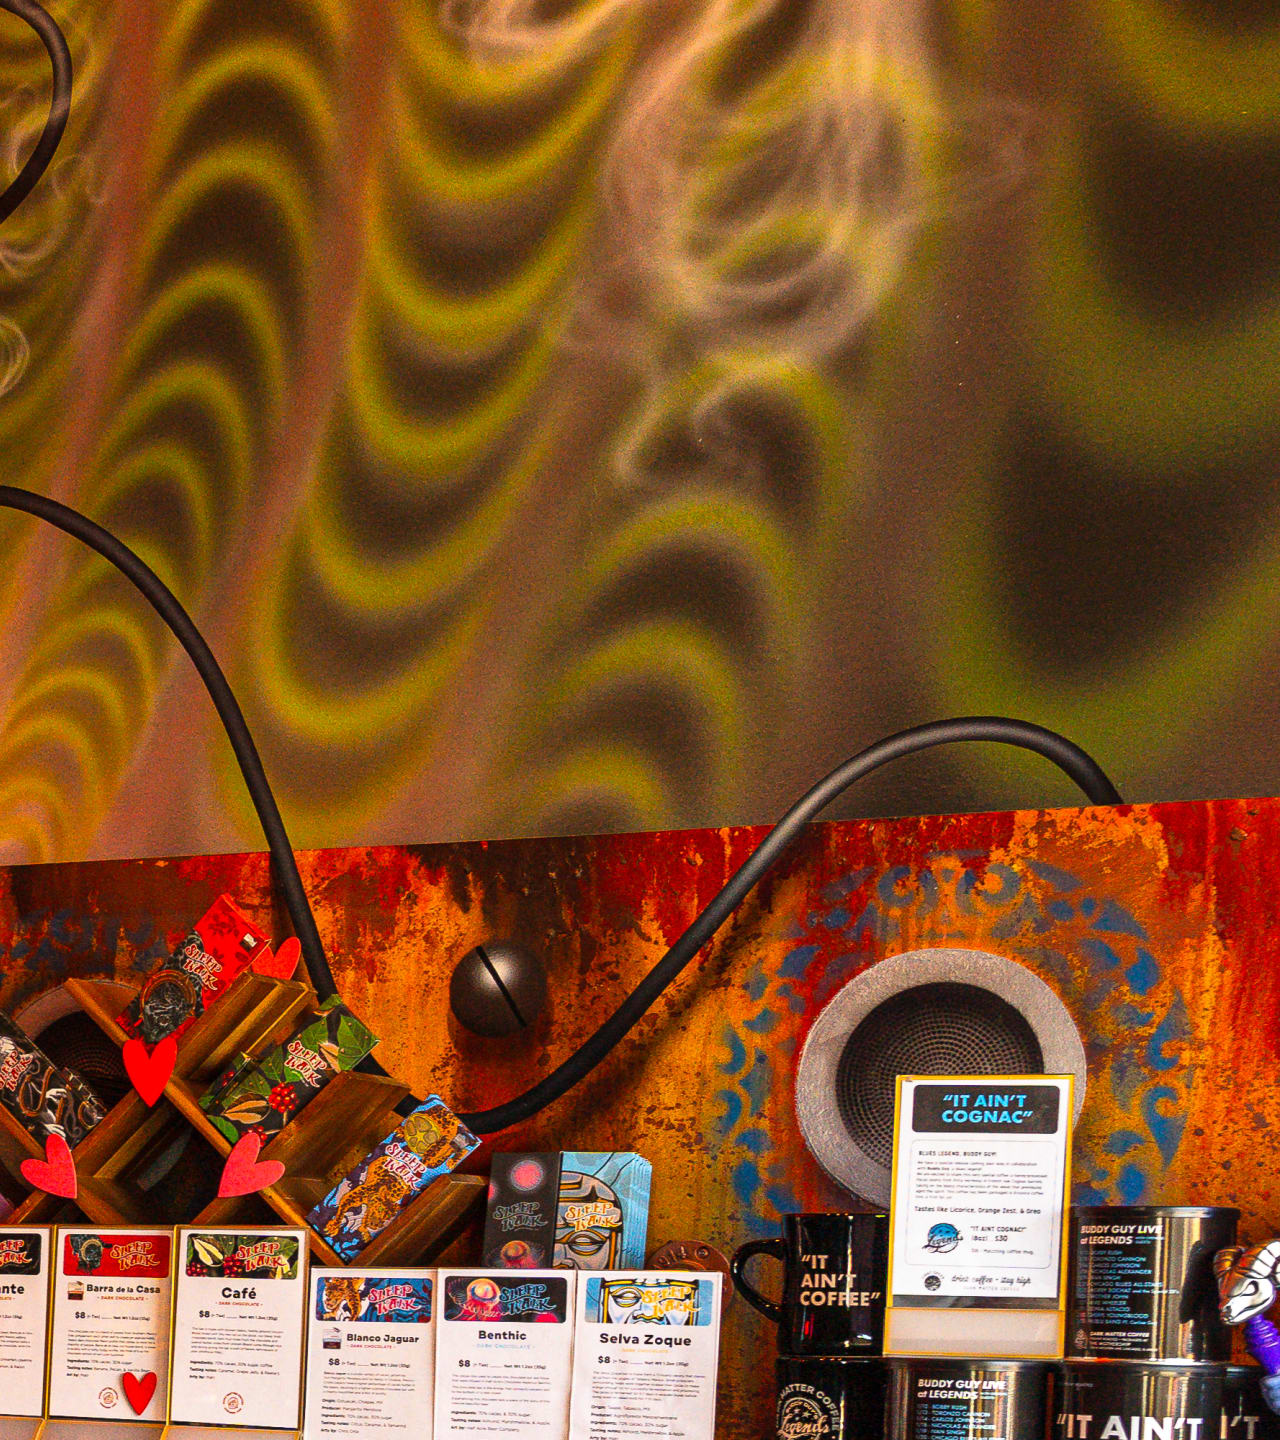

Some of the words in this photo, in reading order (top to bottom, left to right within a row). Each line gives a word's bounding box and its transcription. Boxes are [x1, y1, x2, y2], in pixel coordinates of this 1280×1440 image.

[943, 1095, 971, 1107] "IT
[974, 1095, 1027, 1108] AIN'T
[941, 1110, 1033, 1123] COGNAC"
[386, 1142, 427, 1174] SLEEP
[381, 1157, 420, 1190] WALK
[565, 1201, 614, 1220] SLEEP
[950, 1206, 976, 1214] Licorice,
[978, 1207, 1000, 1215] Orange
[574, 1212, 621, 1232] WALK
[1080, 1225, 1109, 1234] BUDDY
[1111, 1225, 1136, 1234] GUY
[1137, 1225, 1162, 1234] LIVE
[1088, 1236, 1133, 1245] LEGENDS
[236, 1242, 281, 1260] SLEEP
[245, 1254, 286, 1272] WALK
[801, 1255, 828, 1270] "IT
[800, 1274, 856, 1289] AIN'T
[86, 1284, 114, 1293] Barra
[136, 1285, 161, 1294] Casa
[221, 1287, 257, 1300] Café
[800, 1292, 880, 1307] COFFEE"
[346, 1333, 381, 1342] Blanco
[383, 1334, 419, 1344] Jaguar
[478, 1330, 527, 1341] Benthic
[600, 1333, 639, 1345] Selva
[644, 1334, 692, 1347] Zoque
[328, 1358, 340, 1366] $8
[458, 1359, 471, 1368] $8
[597, 1356, 611, 1364] $8
[918, 1379, 952, 1388] BUDDY
[956, 1380, 981, 1389] GUY
[982, 1380, 1007, 1390] LIVE
[929, 1390, 978, 1399] LEGENDS
[780, 1383, 815, 1399] MATTER
[816, 1391, 840, 1430] COFFEE
[1056, 1413, 1093, 1439] "IT
